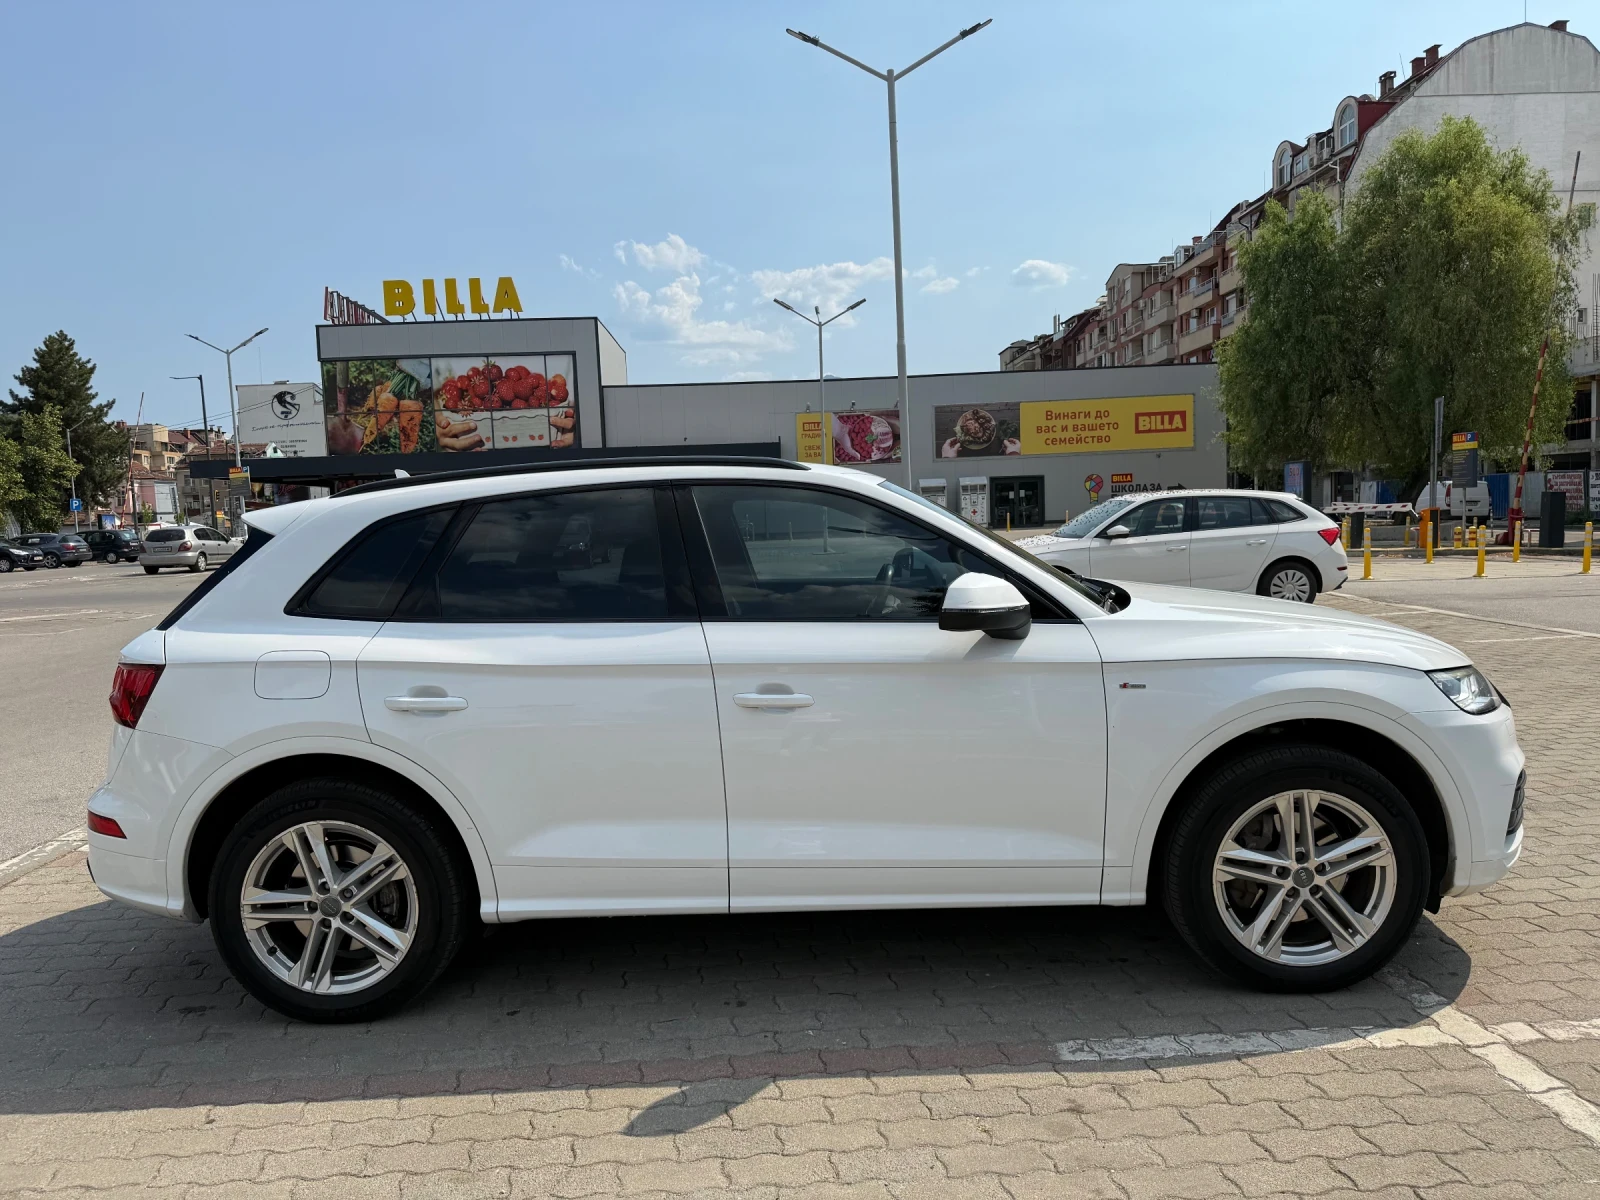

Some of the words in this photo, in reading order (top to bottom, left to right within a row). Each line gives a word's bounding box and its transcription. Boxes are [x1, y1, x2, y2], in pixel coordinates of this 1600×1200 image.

[383, 277, 523, 316] BILLA
[1045, 410, 1091, 421] Винаги
[1094, 409, 1110, 420] до
[1036, 424, 1057, 434] вас
[1061, 424, 1068, 433] и
[1072, 421, 1119, 433] вашето
[1138, 414, 1183, 431] BILLA
[1044, 433, 1111, 446] семейство
[1112, 474, 1131, 482] BILLA
[1111, 484, 1148, 493] ШКОЛА
[1149, 483, 1162, 491] ЗА
